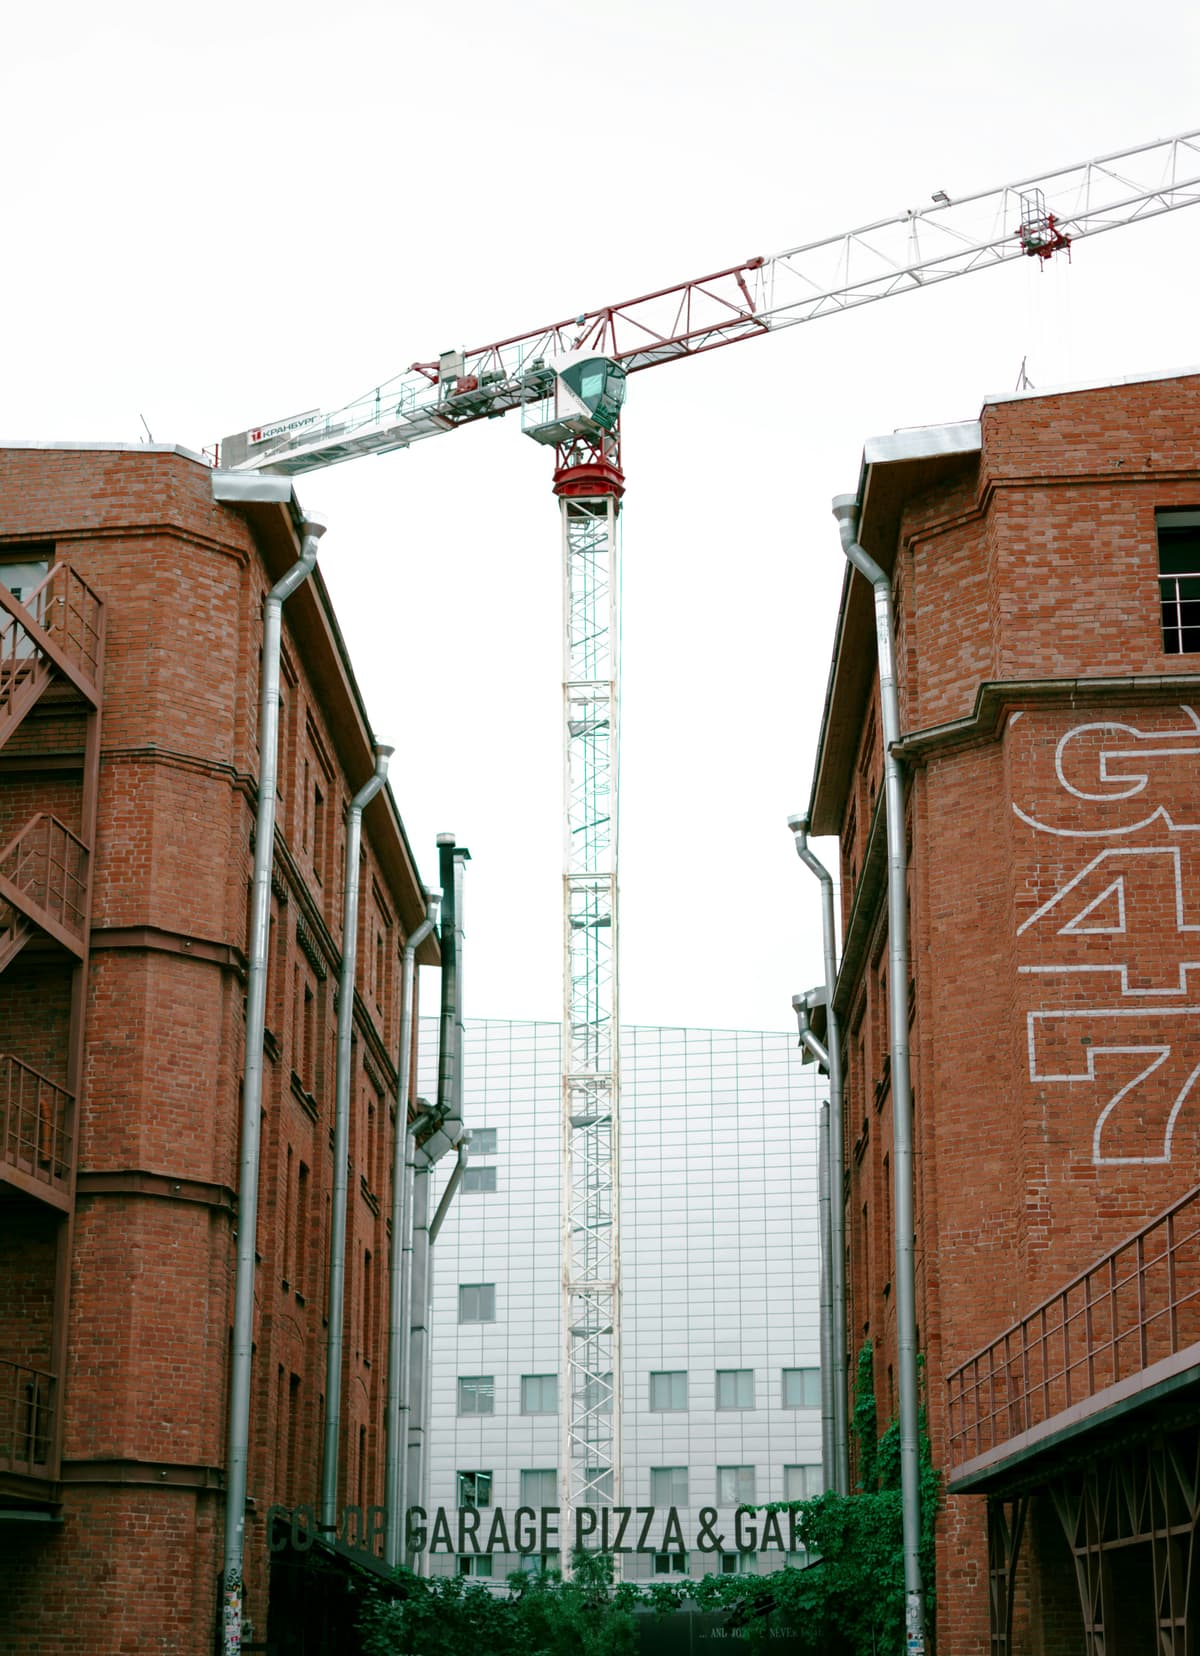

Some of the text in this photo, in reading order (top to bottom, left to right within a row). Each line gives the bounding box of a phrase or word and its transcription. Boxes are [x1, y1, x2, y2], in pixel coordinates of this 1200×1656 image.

[262, 416, 318, 439] КРАНБУРГ
[405, 1505, 561, 1553] GARAGE
[575, 1506, 686, 1553] PIZZA
[697, 1506, 725, 1553] &
